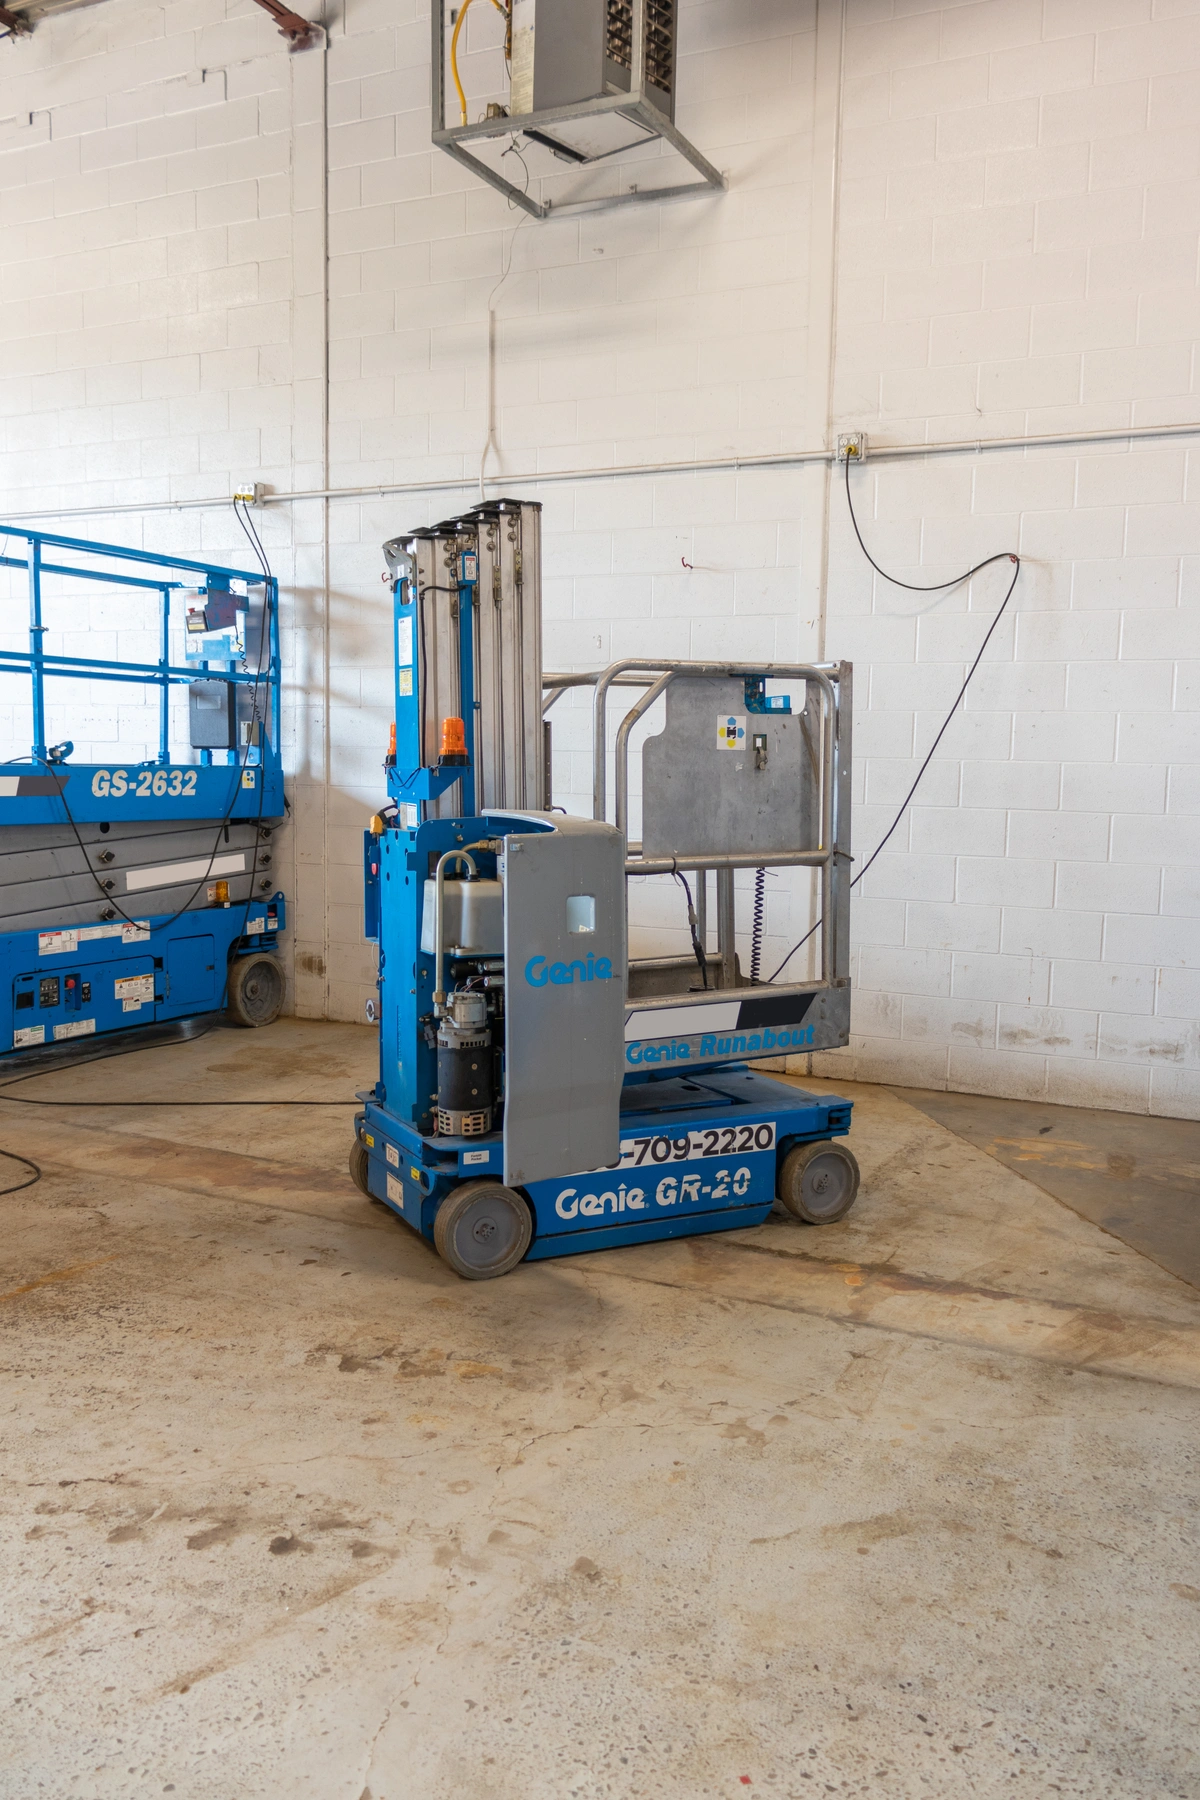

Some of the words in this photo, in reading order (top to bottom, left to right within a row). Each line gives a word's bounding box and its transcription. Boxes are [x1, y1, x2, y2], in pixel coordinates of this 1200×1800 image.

[92, 769, 198, 797] GS-2632
[524, 951, 613, 988] Genie
[626, 1038, 691, 1065] Genie
[700, 1024, 815, 1057] Runabout
[587, 1123, 774, 1172] -709-2220
[555, 1183, 646, 1220] Genie
[655, 1167, 751, 1207] GR-20
